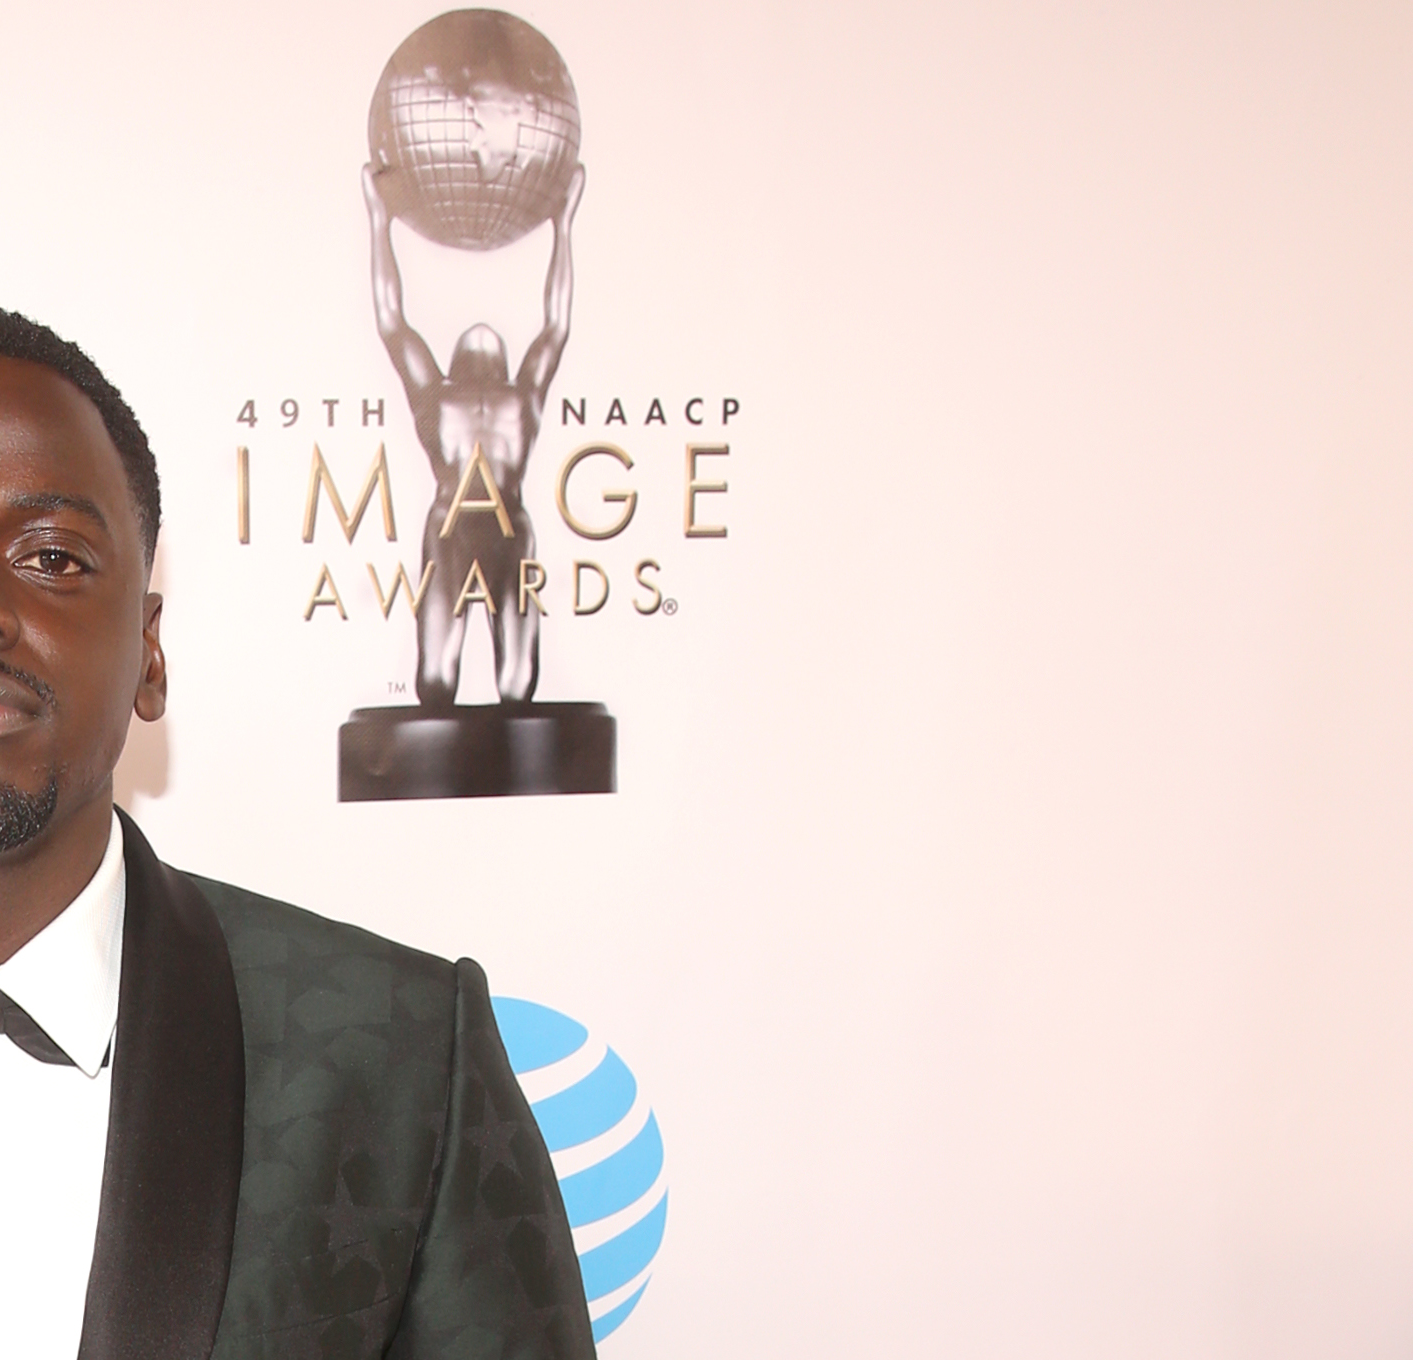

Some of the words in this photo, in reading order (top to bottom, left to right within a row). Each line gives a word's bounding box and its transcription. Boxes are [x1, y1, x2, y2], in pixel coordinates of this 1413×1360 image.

[237, 398, 386, 428] 49TH
[561, 397, 741, 427] NAACP
[237, 441, 730, 545] IMAGE
